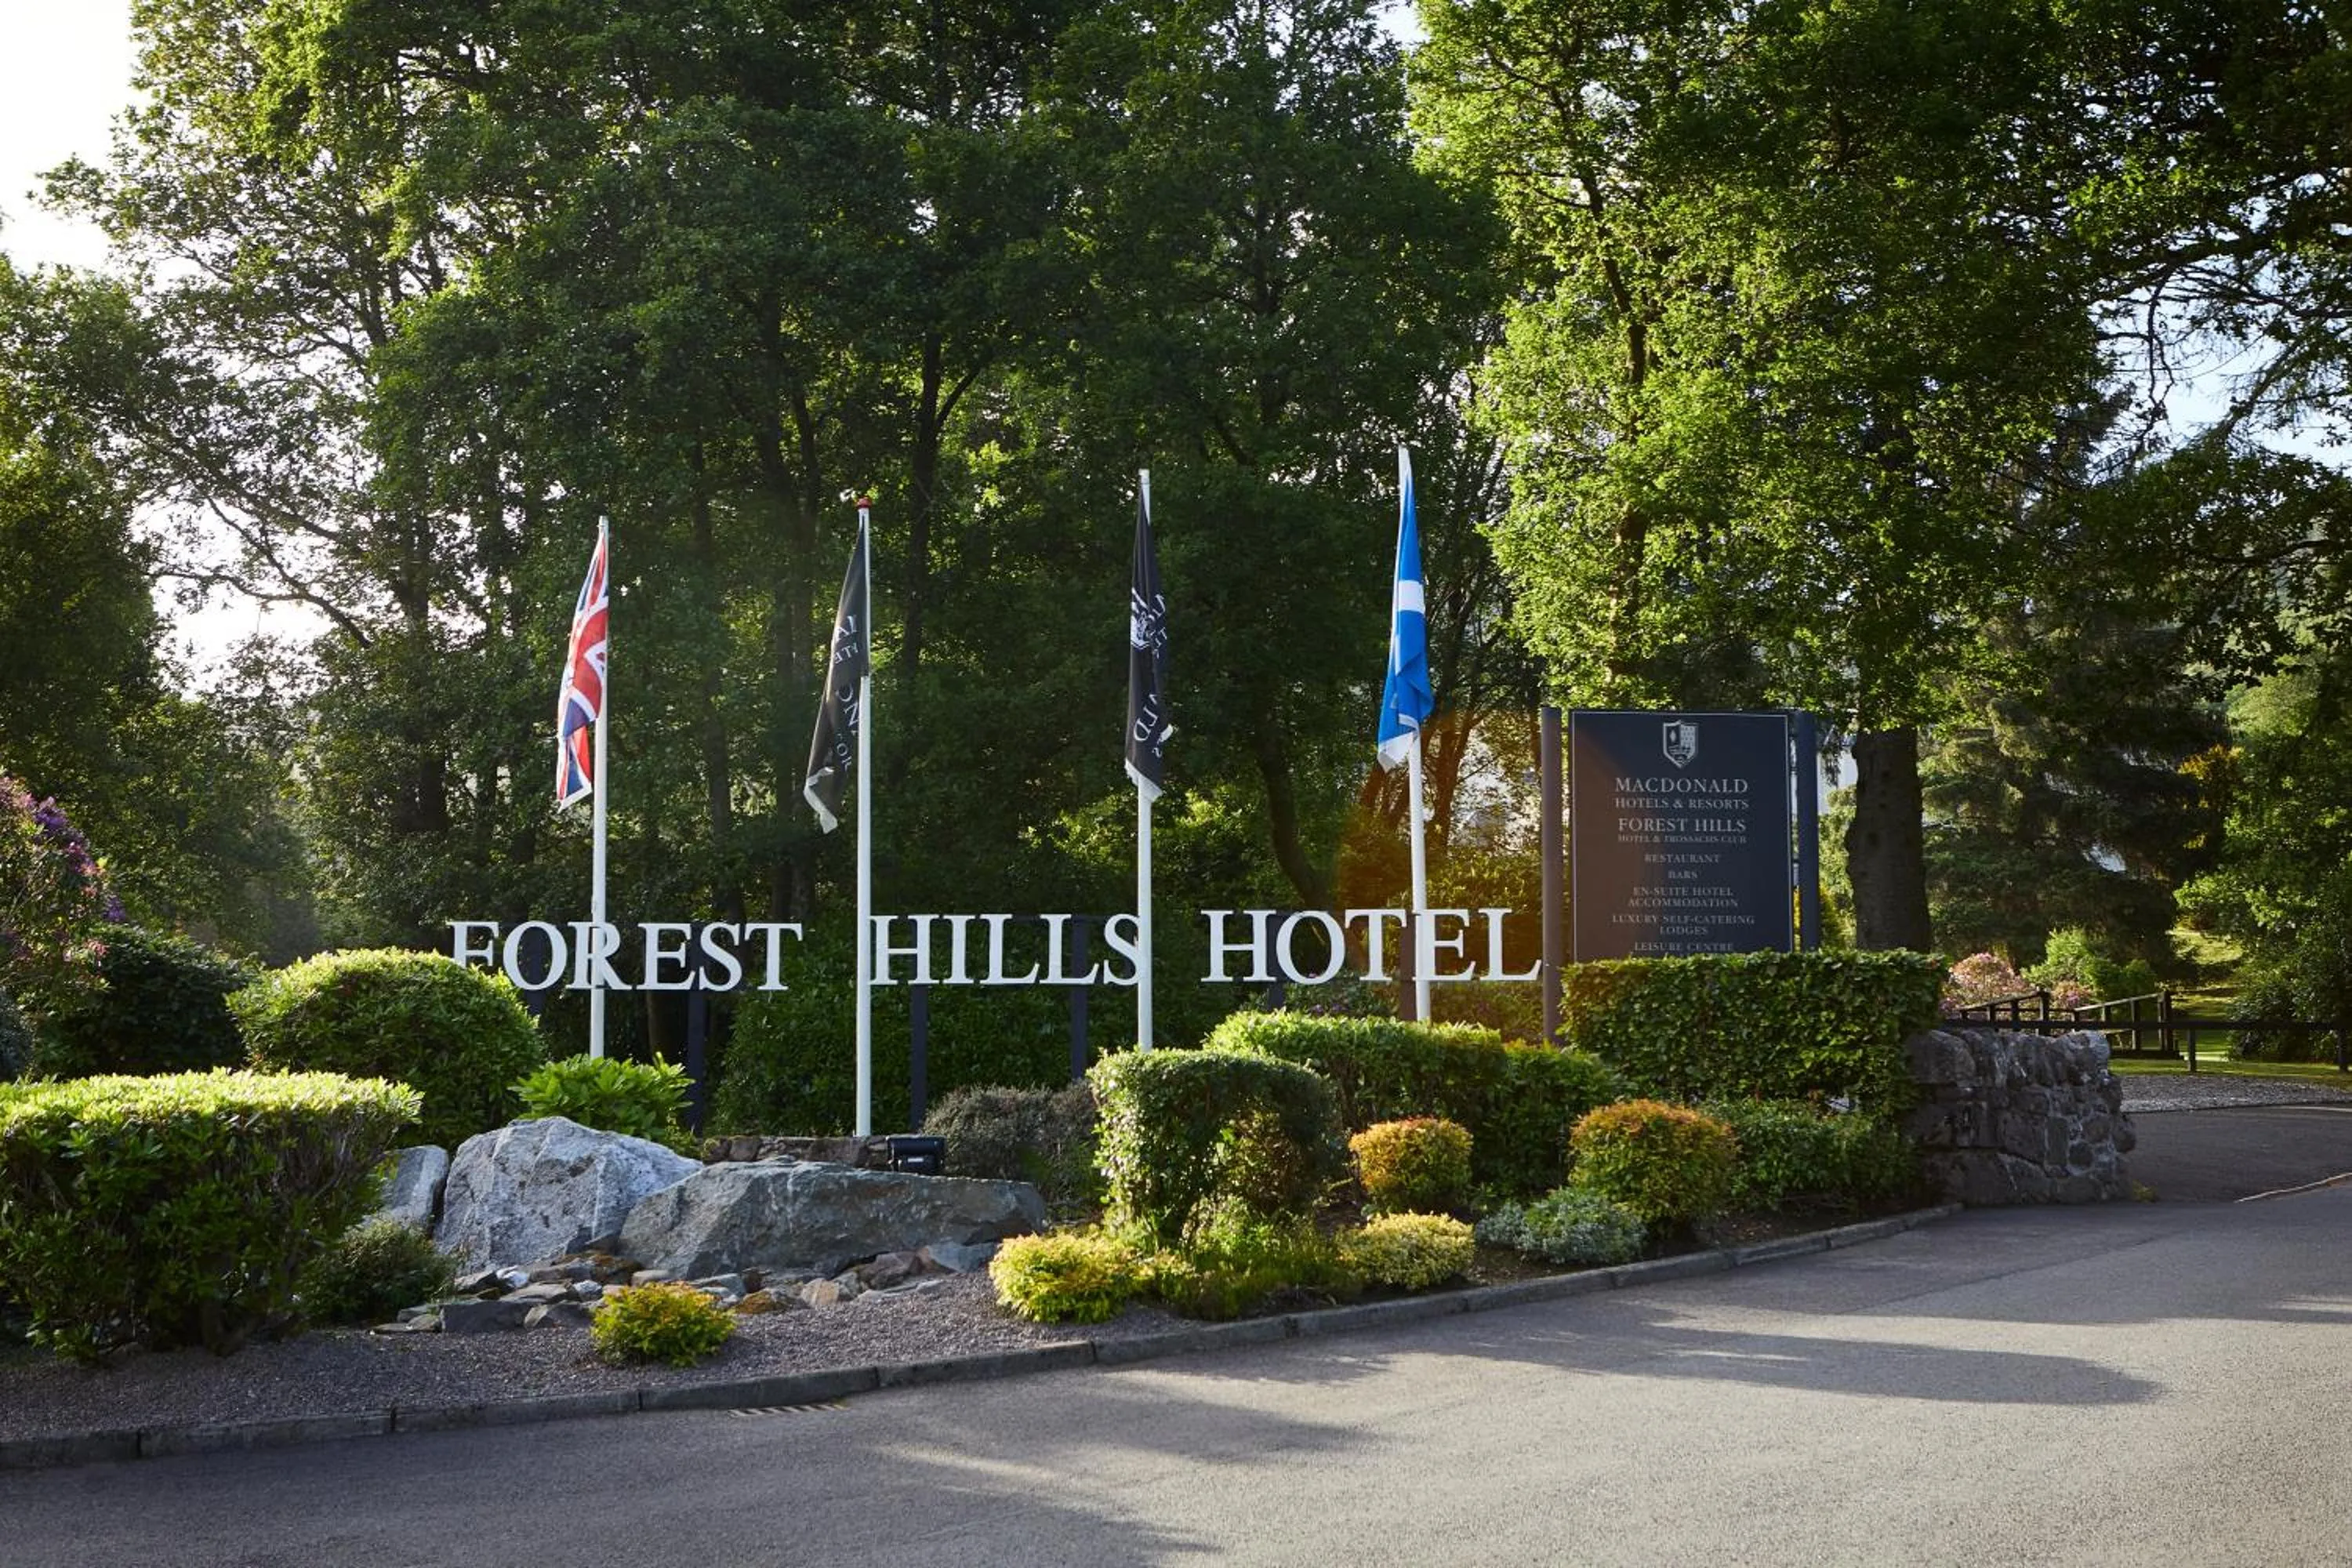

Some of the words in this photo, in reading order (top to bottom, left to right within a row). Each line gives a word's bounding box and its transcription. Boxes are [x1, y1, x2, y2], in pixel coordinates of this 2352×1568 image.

[1615, 778, 1748, 793] MACDONALD
[1614, 797, 1669, 809] HOTELS
[1672, 799, 1683, 809] &
[1688, 798, 1749, 810] RESORTS
[1617, 818, 1688, 832] FOREST
[1695, 818, 1747, 833] HILLS
[1644, 853, 1721, 863] RESTAURANT
[1668, 869, 1699, 879] BARS
[1633, 887, 1690, 896] EN-SUITE
[1693, 887, 1733, 896] HOTEL
[1628, 898, 1740, 908] ACCOMMODATION
[1612, 913, 1658, 924] LUXURY
[1662, 914, 1755, 924] SELF-CATERING
[1660, 926, 1708, 935] LODGES
[446, 920, 804, 992] FOREST
[869, 913, 1139, 986] HILLS
[1200, 908, 1542, 985] HOTEL
[1634, 942, 1682, 951] LEISURE
[1686, 942, 1734, 952] CENTRE
